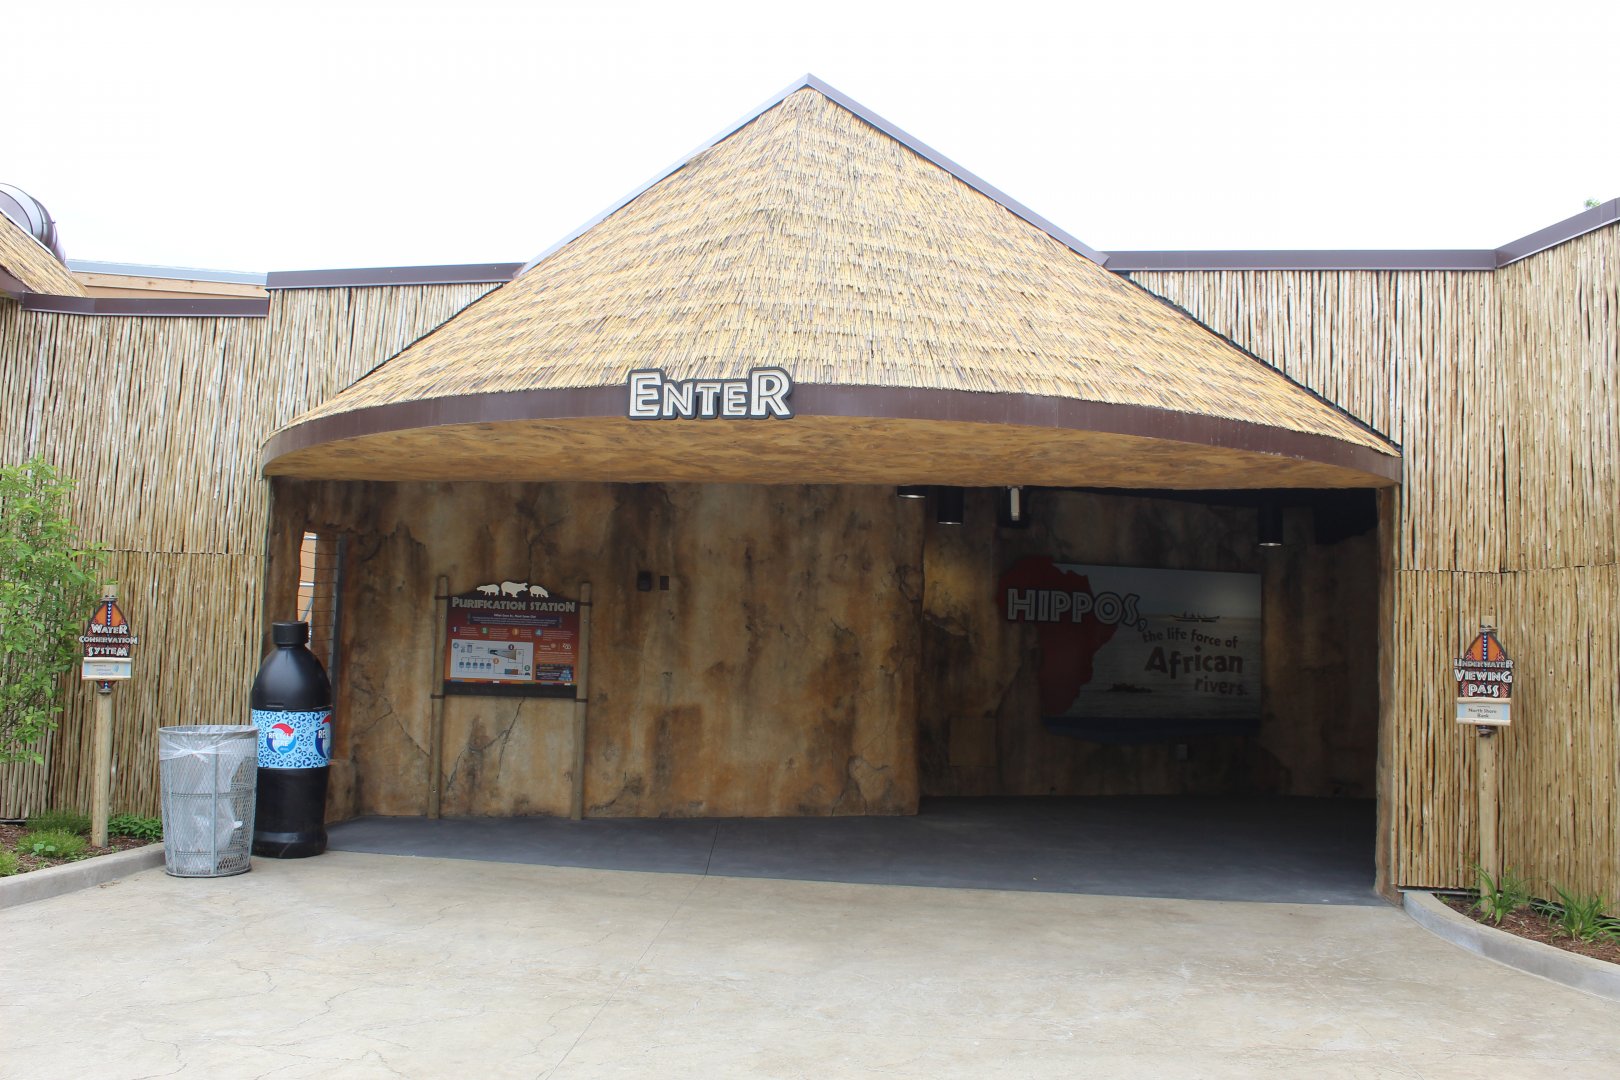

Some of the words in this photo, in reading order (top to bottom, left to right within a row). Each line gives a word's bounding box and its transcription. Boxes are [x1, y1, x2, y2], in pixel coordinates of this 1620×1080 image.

[628, 368, 793, 418] ENTER
[451, 596, 526, 611] PURIFICATION
[530, 601, 576, 613] STATION
[1007, 588, 1148, 632] HIPPOS,
[91, 623, 128, 634] WATER
[79, 635, 138, 645] CONSERVATION
[1142, 629, 1163, 644] the
[1167, 627, 1187, 641] life
[1191, 628, 1221, 647] force
[1225, 635, 1238, 649] of
[88, 646, 128, 657] SYSTEM
[1144, 645, 1243, 680] African
[1454, 658, 1514, 669] UNDERWATER
[1454, 669, 1513, 683] VIEWING
[1194, 675, 1249, 697] rivers.
[1468, 683, 1500, 698] PASS
